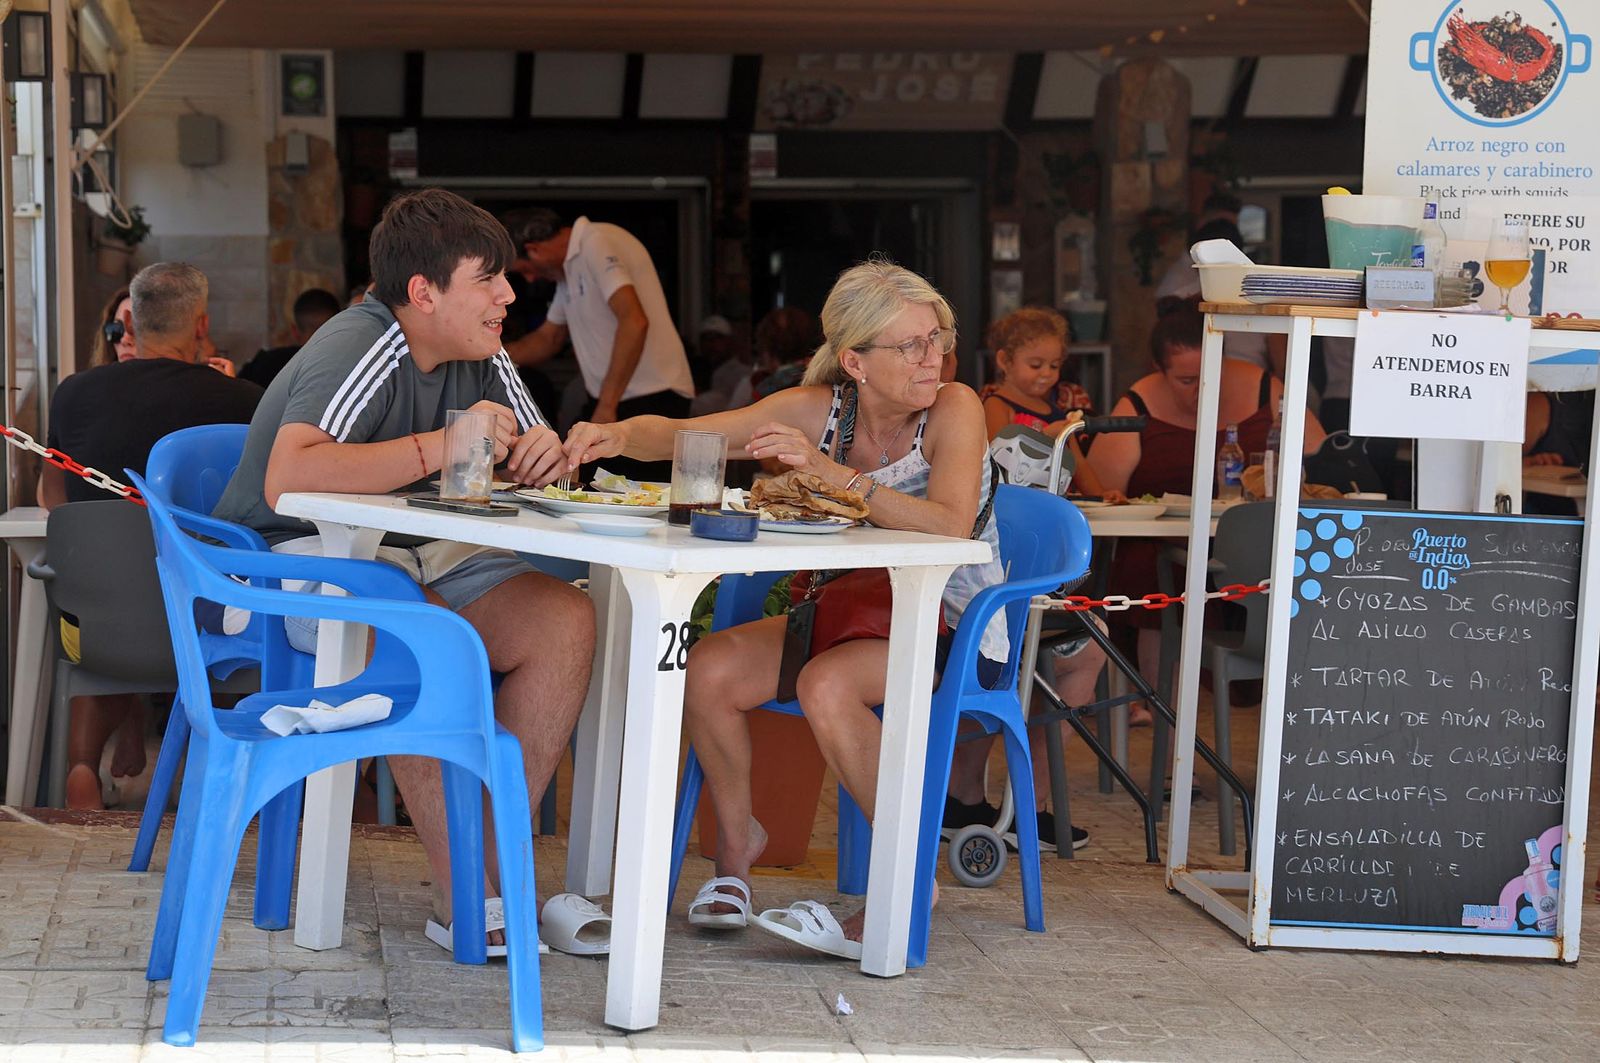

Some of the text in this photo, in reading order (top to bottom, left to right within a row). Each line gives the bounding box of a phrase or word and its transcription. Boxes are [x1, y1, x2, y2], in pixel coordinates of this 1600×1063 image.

[1426, 137, 1566, 157] Arroz negro con
[1396, 160, 1593, 182] calamares y carabinero
[1565, 215, 1586, 229] SU
[1558, 239, 1591, 252] POR
[1431, 333, 1458, 348] NO
[1372, 355, 1510, 377] ATENDEMOS EN
[1409, 382, 1473, 400] BARRA
[1412, 527, 1467, 550] Puerto
[1416, 546, 1472, 570] Indias
[1336, 586, 1577, 620] GYOZAS DE GAMBAS
[1311, 616, 1532, 644] AL AJILLO CASERAS
[657, 620, 691, 671] 28
[1310, 666, 1413, 688] TARTAR
[1426, 669, 1454, 688] DE
[1302, 706, 1390, 728] TATAKI
[1400, 711, 1430, 727] DE
[1440, 707, 1491, 729] ATÚN
[1304, 742, 1396, 766] LASAÑA
[1303, 783, 1449, 806] ALCACHOFAS
[1293, 822, 1487, 849] ENSALADILLA DE
[1286, 887, 1399, 907] MERLUZA
